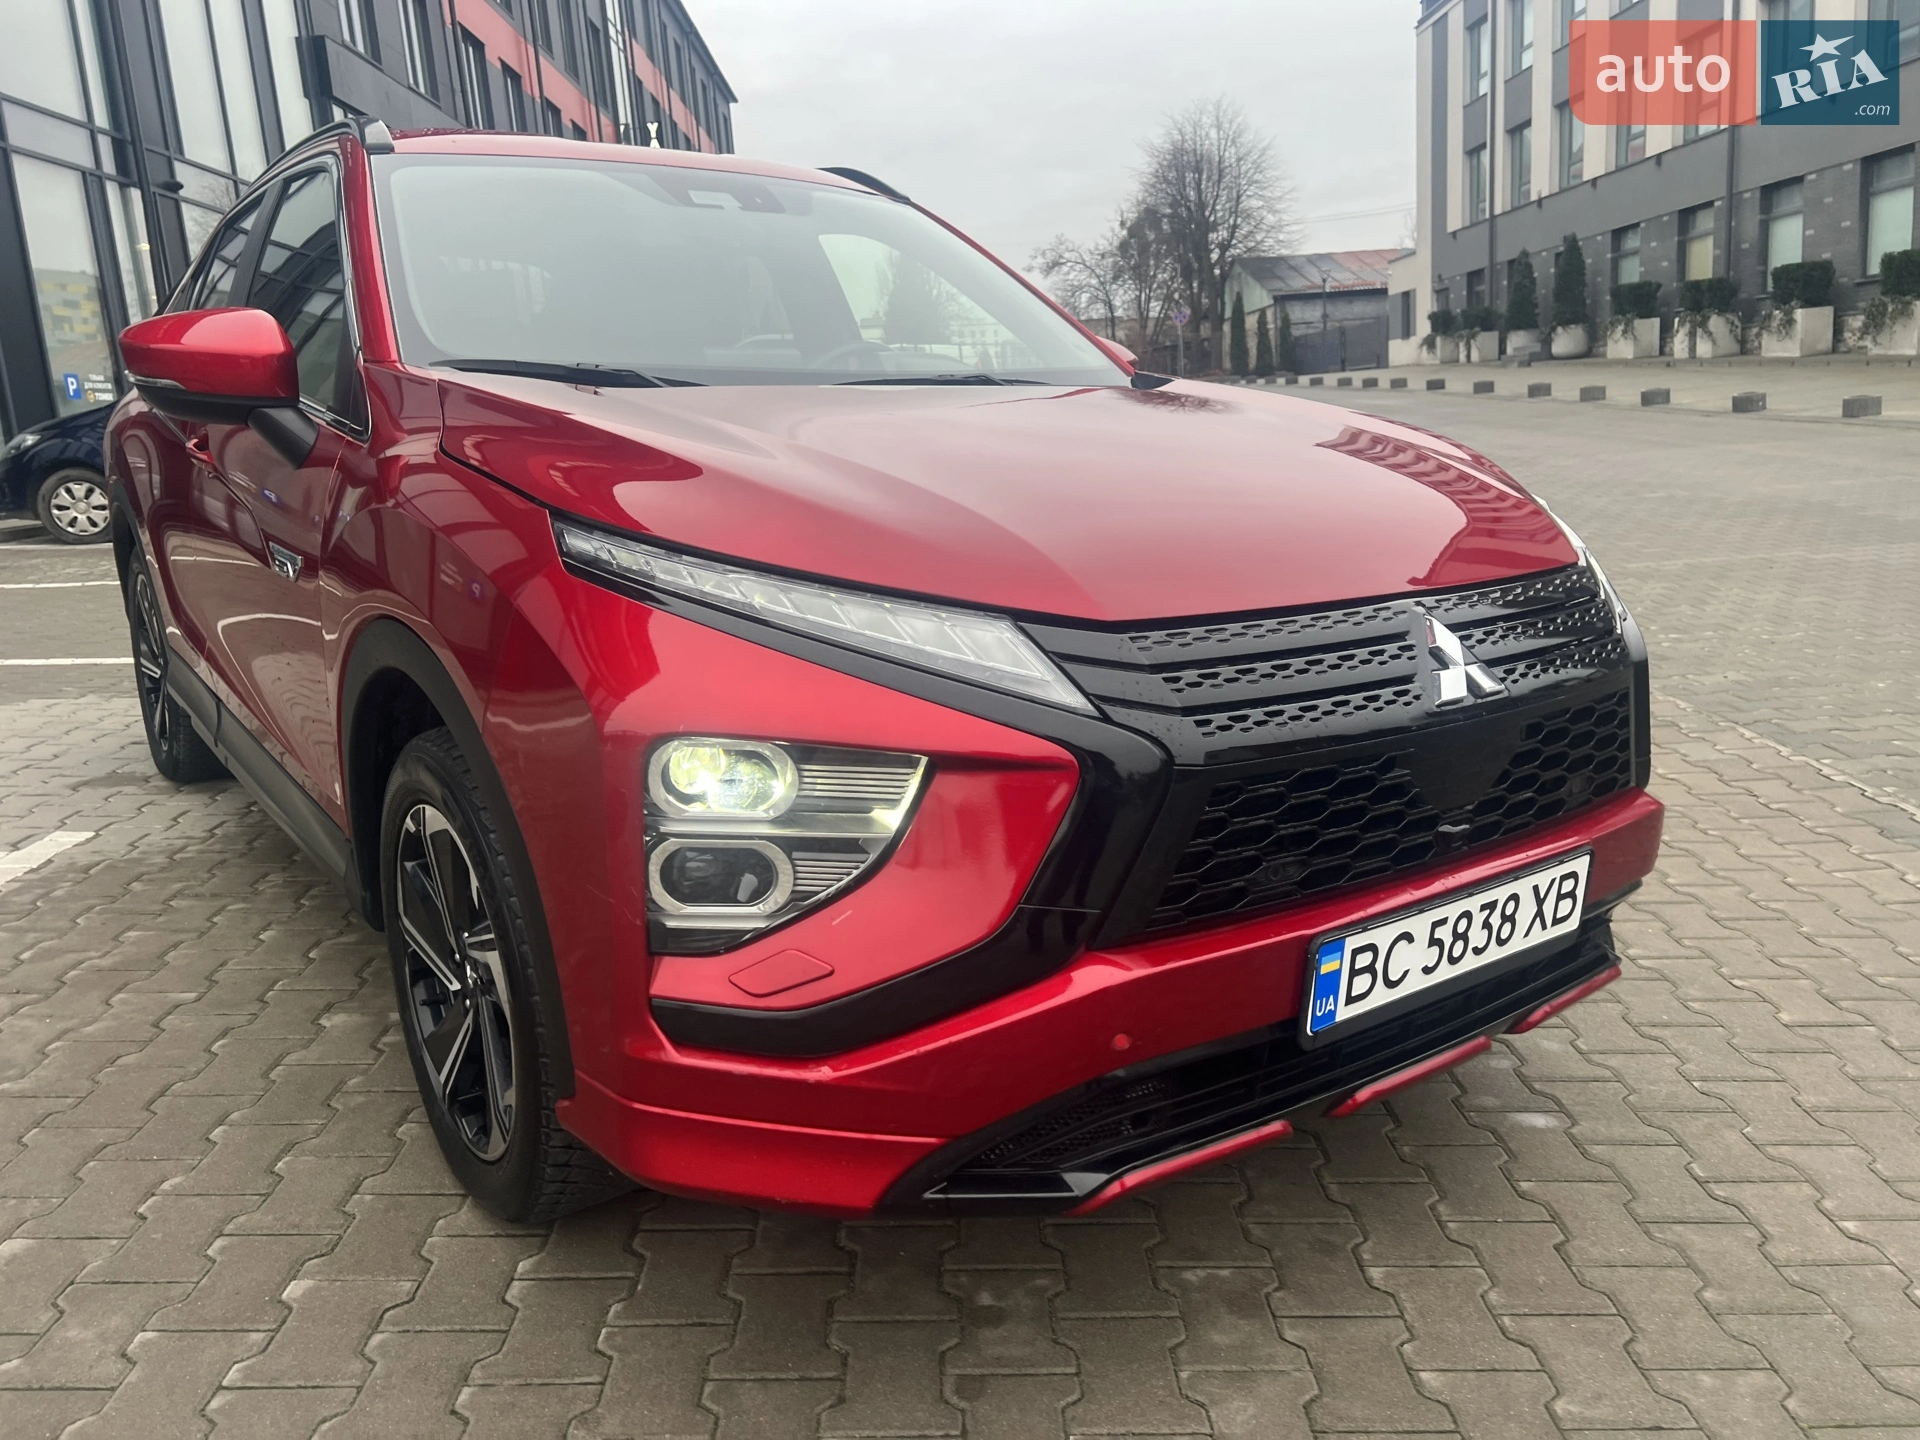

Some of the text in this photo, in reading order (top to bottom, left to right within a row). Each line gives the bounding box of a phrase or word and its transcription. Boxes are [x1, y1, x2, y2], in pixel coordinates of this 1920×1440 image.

[67, 377, 77, 396] P
[1344, 870, 1580, 1007] BC 5838 XB
[1315, 995, 1335, 1017] UA
